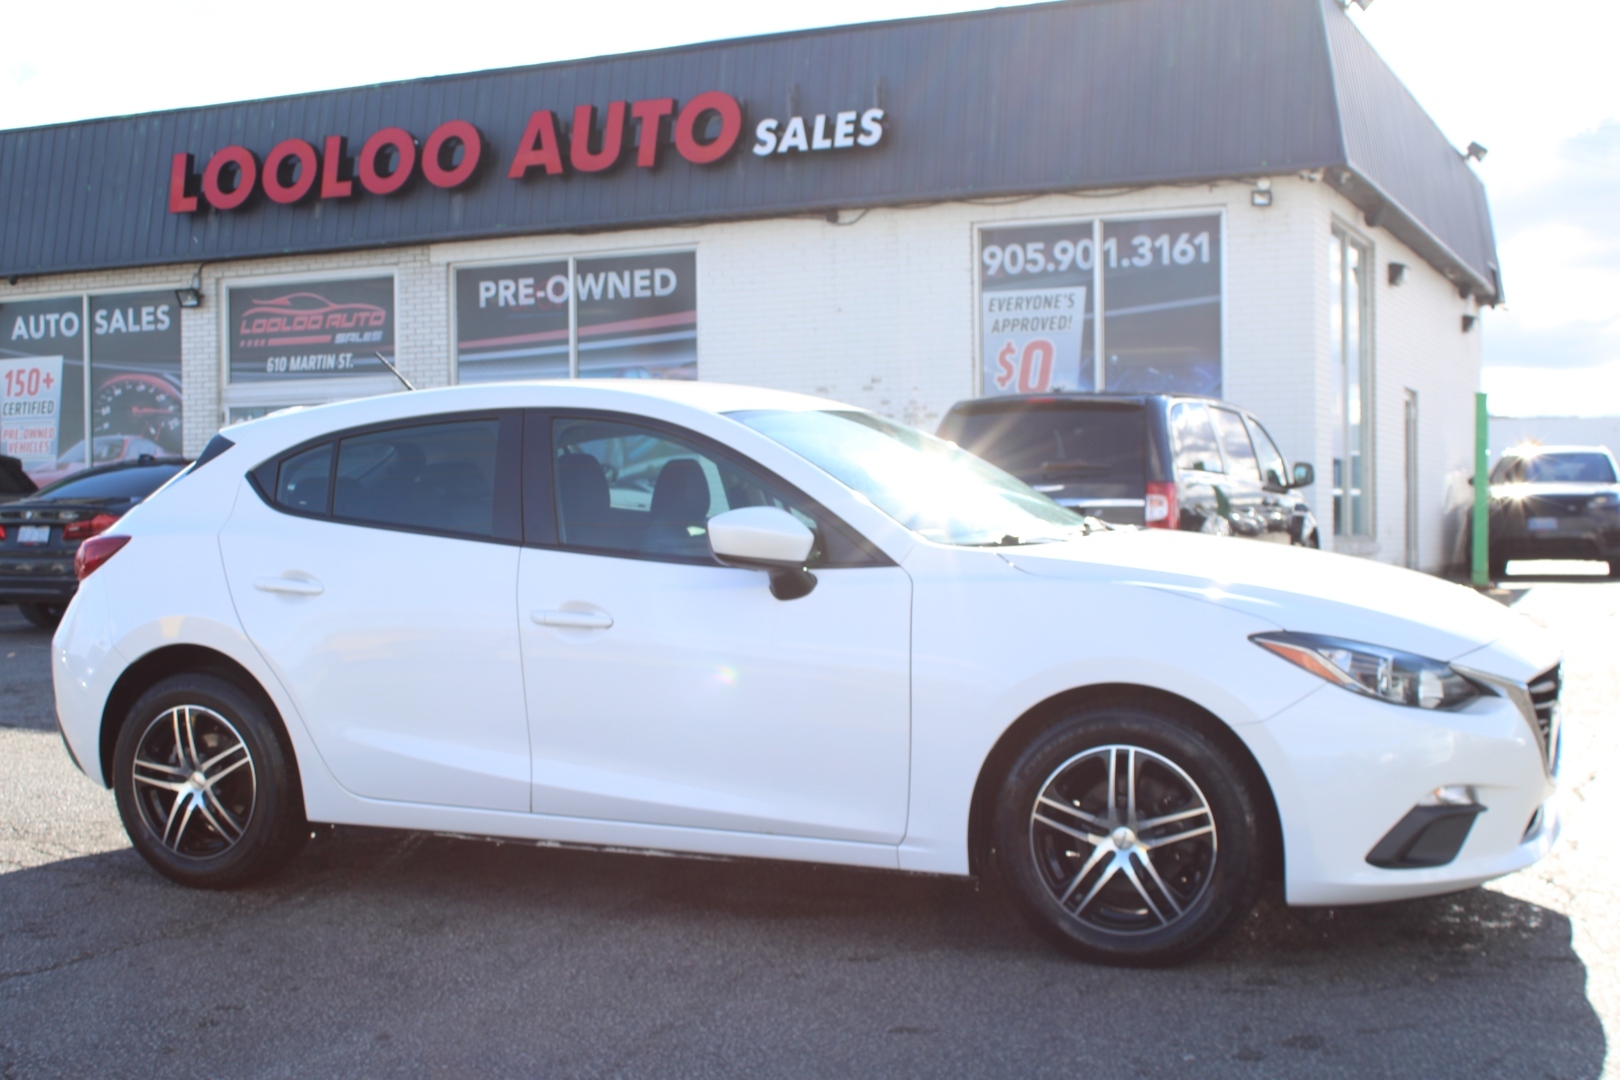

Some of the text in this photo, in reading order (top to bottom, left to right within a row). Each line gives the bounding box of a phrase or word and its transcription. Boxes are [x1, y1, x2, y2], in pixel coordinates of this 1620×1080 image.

[169, 90, 885, 214] LOOLOO AUTO SALES
[982, 231, 1210, 276] 905.901.3161
[479, 268, 677, 308] PRE-OWNED
[988, 293, 1076, 313] EVERYONE'S
[11, 304, 171, 341] AUTO SALES
[240, 310, 387, 335] LOOLOO AUTO
[991, 315, 1073, 334] APPROVED!
[334, 331, 384, 345] SALES
[266, 353, 354, 373] 610 MARTIN ST.
[996, 340, 1054, 393] $0
[4, 368, 55, 398] 150+
[2, 400, 55, 416] CERTIFIED
[9, 440, 50, 454] VEHICLES
